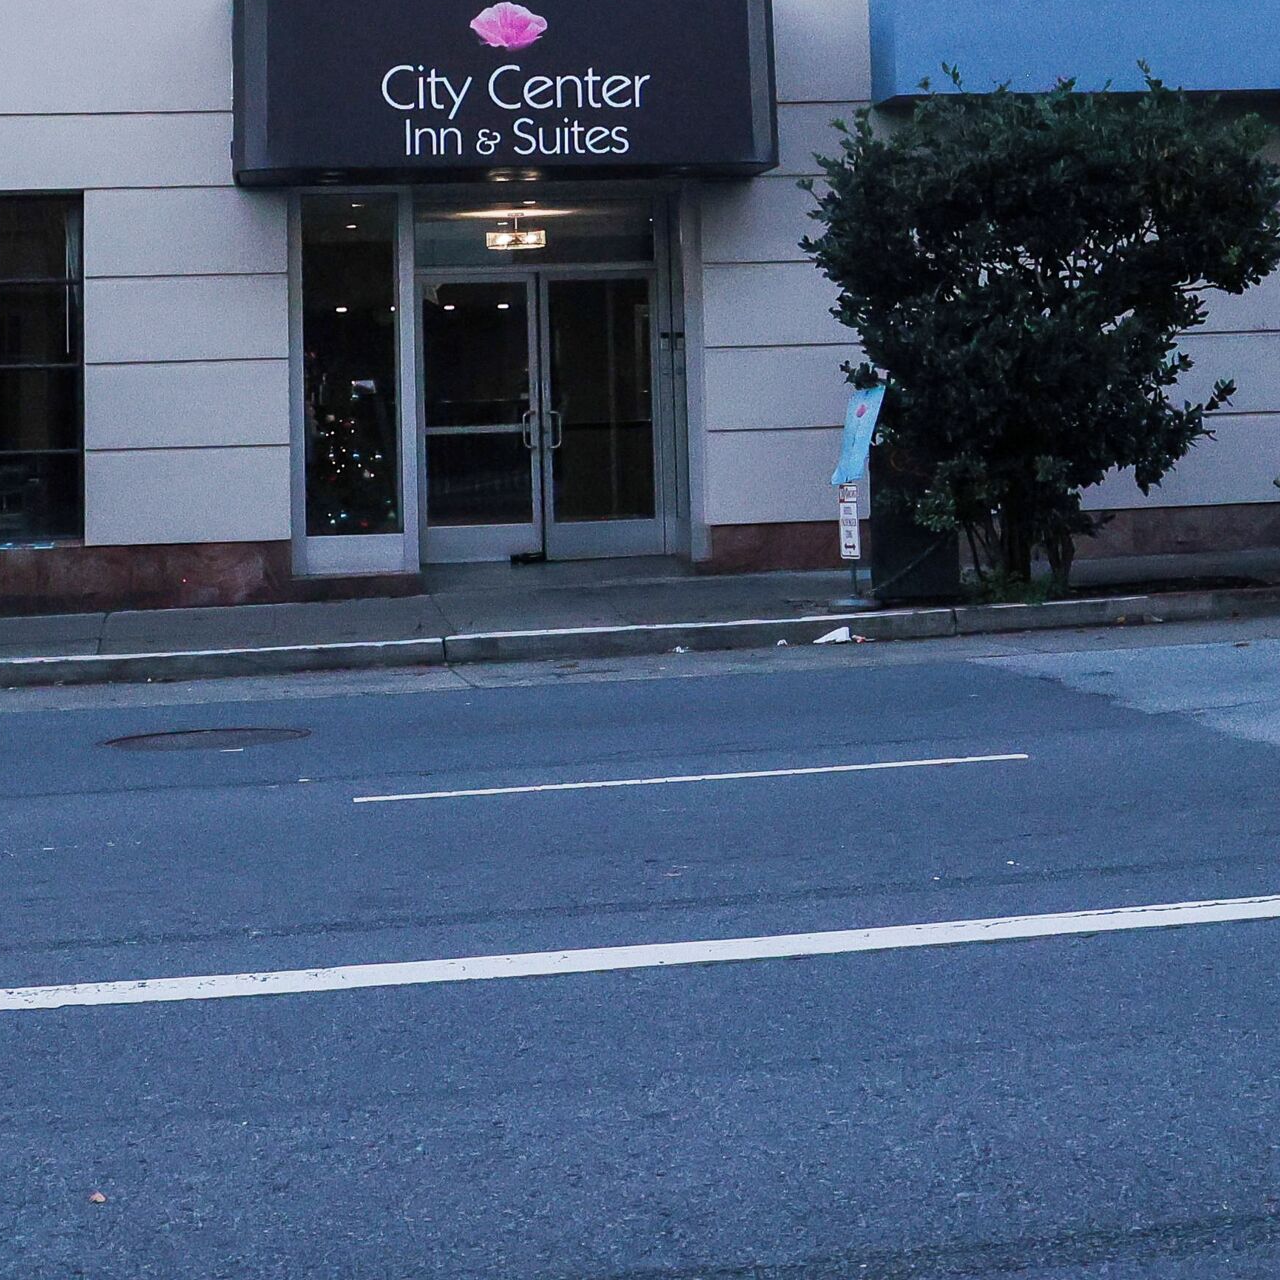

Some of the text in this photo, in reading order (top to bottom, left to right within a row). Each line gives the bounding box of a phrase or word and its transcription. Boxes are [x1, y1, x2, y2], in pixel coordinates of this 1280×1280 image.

[381, 64, 651, 120] City Center
[405, 117, 630, 156] Inn & Suites
